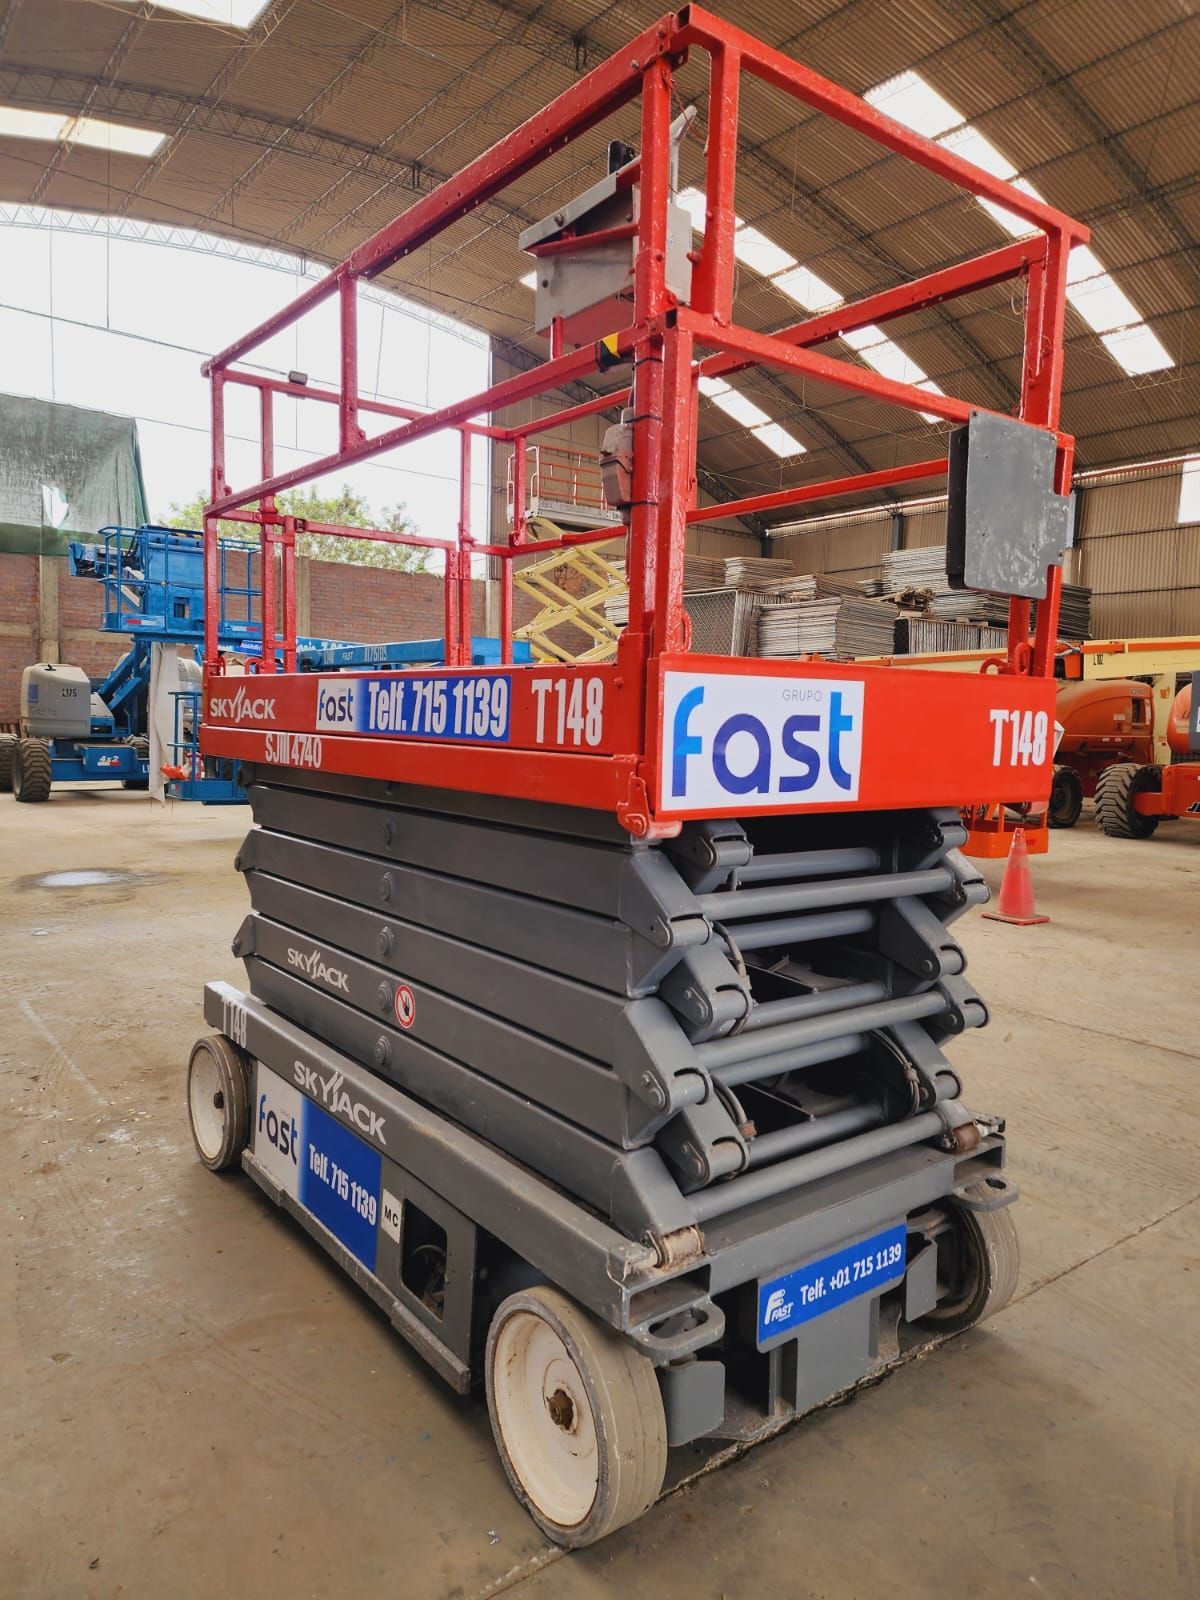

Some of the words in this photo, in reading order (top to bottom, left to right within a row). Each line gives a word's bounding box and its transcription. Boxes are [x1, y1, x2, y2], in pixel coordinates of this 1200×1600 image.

[210, 686, 276, 723] SKYJACK
[318, 687, 353, 722] fast
[368, 681, 407, 731] Telf.
[411, 680, 448, 734] 715
[453, 678, 508, 738] 1139
[530, 677, 604, 747] T148
[782, 688, 822, 702] GRUPO
[291, 734, 321, 769] 4740
[671, 685, 853, 798] fast
[989, 709, 1048, 767] T148
[287, 947, 349, 993] SKYJACK
[259, 1093, 298, 1165] fast
[293, 1060, 387, 1146] SKYJACK
[309, 1143, 329, 1185] Telf.
[331, 1162, 349, 1200] 715
[350, 1181, 377, 1226] 1139
[800, 1276, 827, 1306] Telf.
[829, 1266, 850, 1291] +01
[853, 1255, 873, 1282] 715
[875, 1242, 902, 1271] 1139
[771, 1301, 794, 1322] FAST
